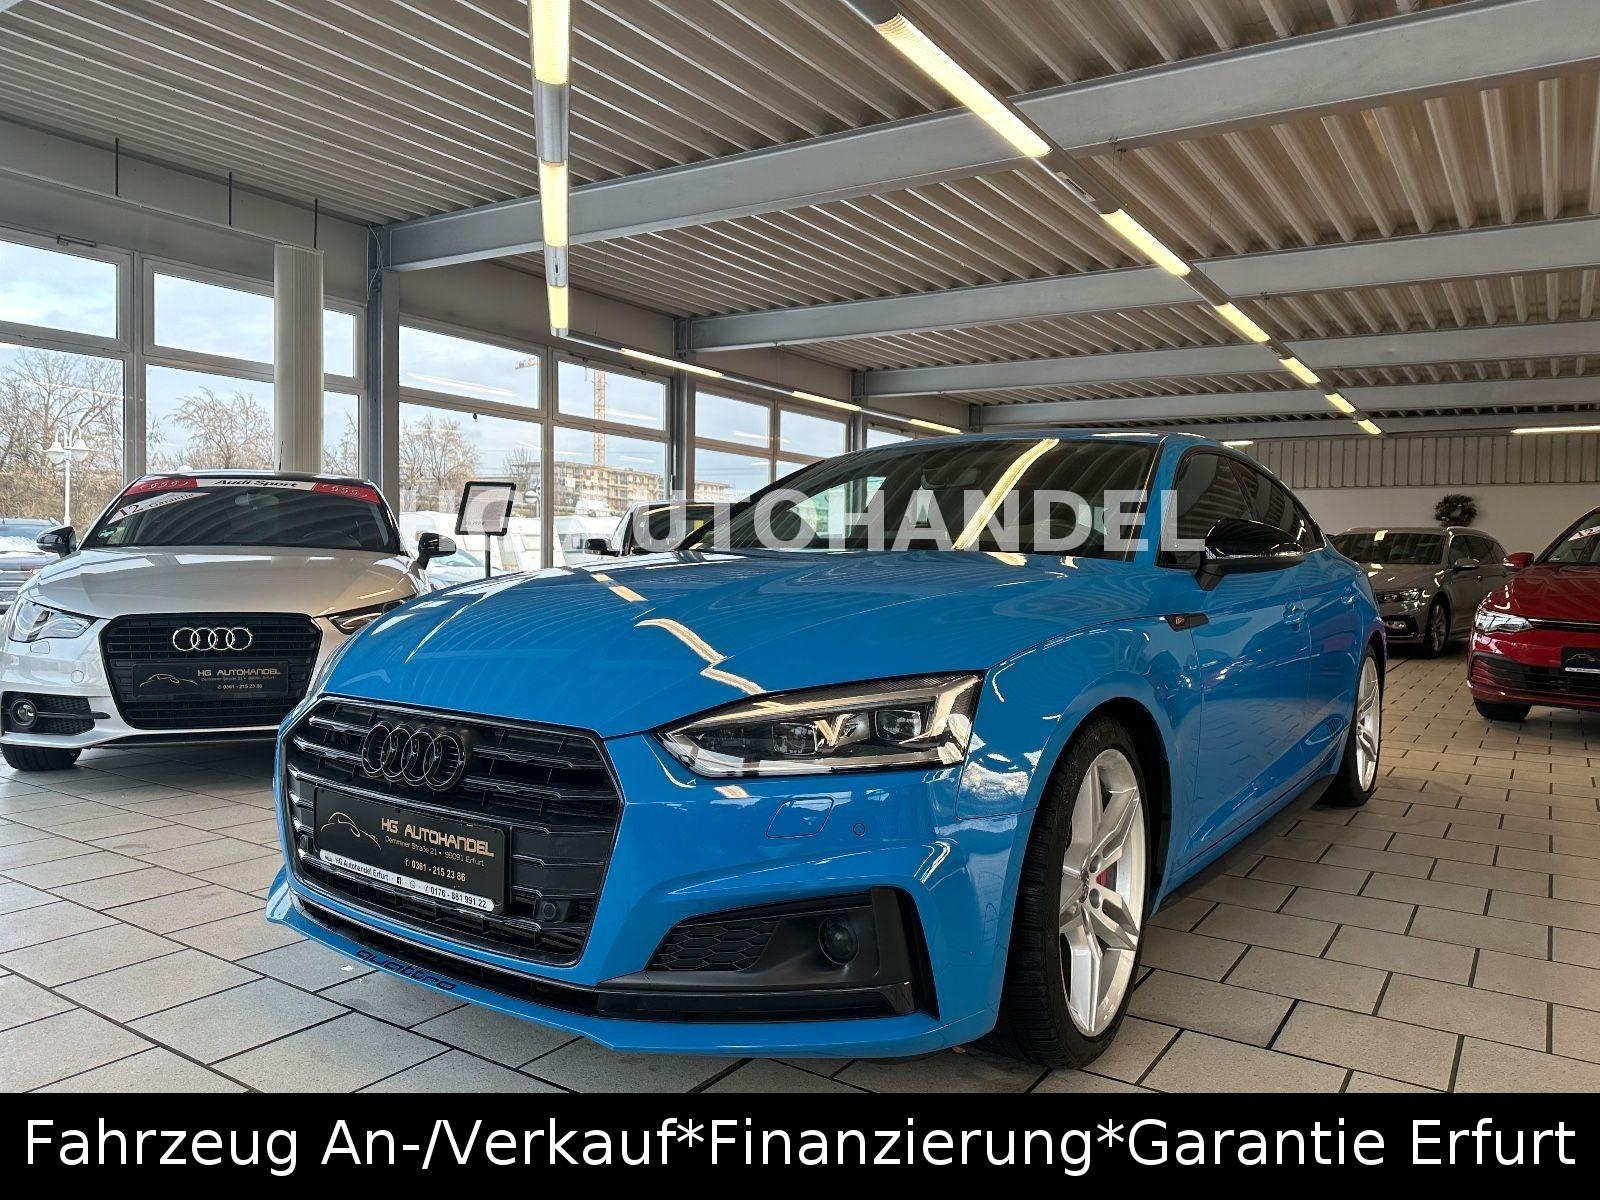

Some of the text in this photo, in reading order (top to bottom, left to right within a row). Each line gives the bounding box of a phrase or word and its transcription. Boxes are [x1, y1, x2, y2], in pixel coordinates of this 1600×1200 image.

[119, 493, 194, 517] 12 Garantie
[197, 668, 281, 677] HG AUTOHANDEL
[381, 817, 495, 857] HG AUTOHANDEL
[429, 847, 437, 856] 21
[465, 856, 485, 867] Erfurt
[411, 860, 427, 872] 0361
[432, 866, 445, 877] 215
[446, 869, 455, 880] 23
[456, 871, 466, 882] 86
[430, 886, 446, 897] 0176
[464, 895, 476, 905] 991
[478, 898, 487, 908] 22
[355, 949, 457, 991] quattro
